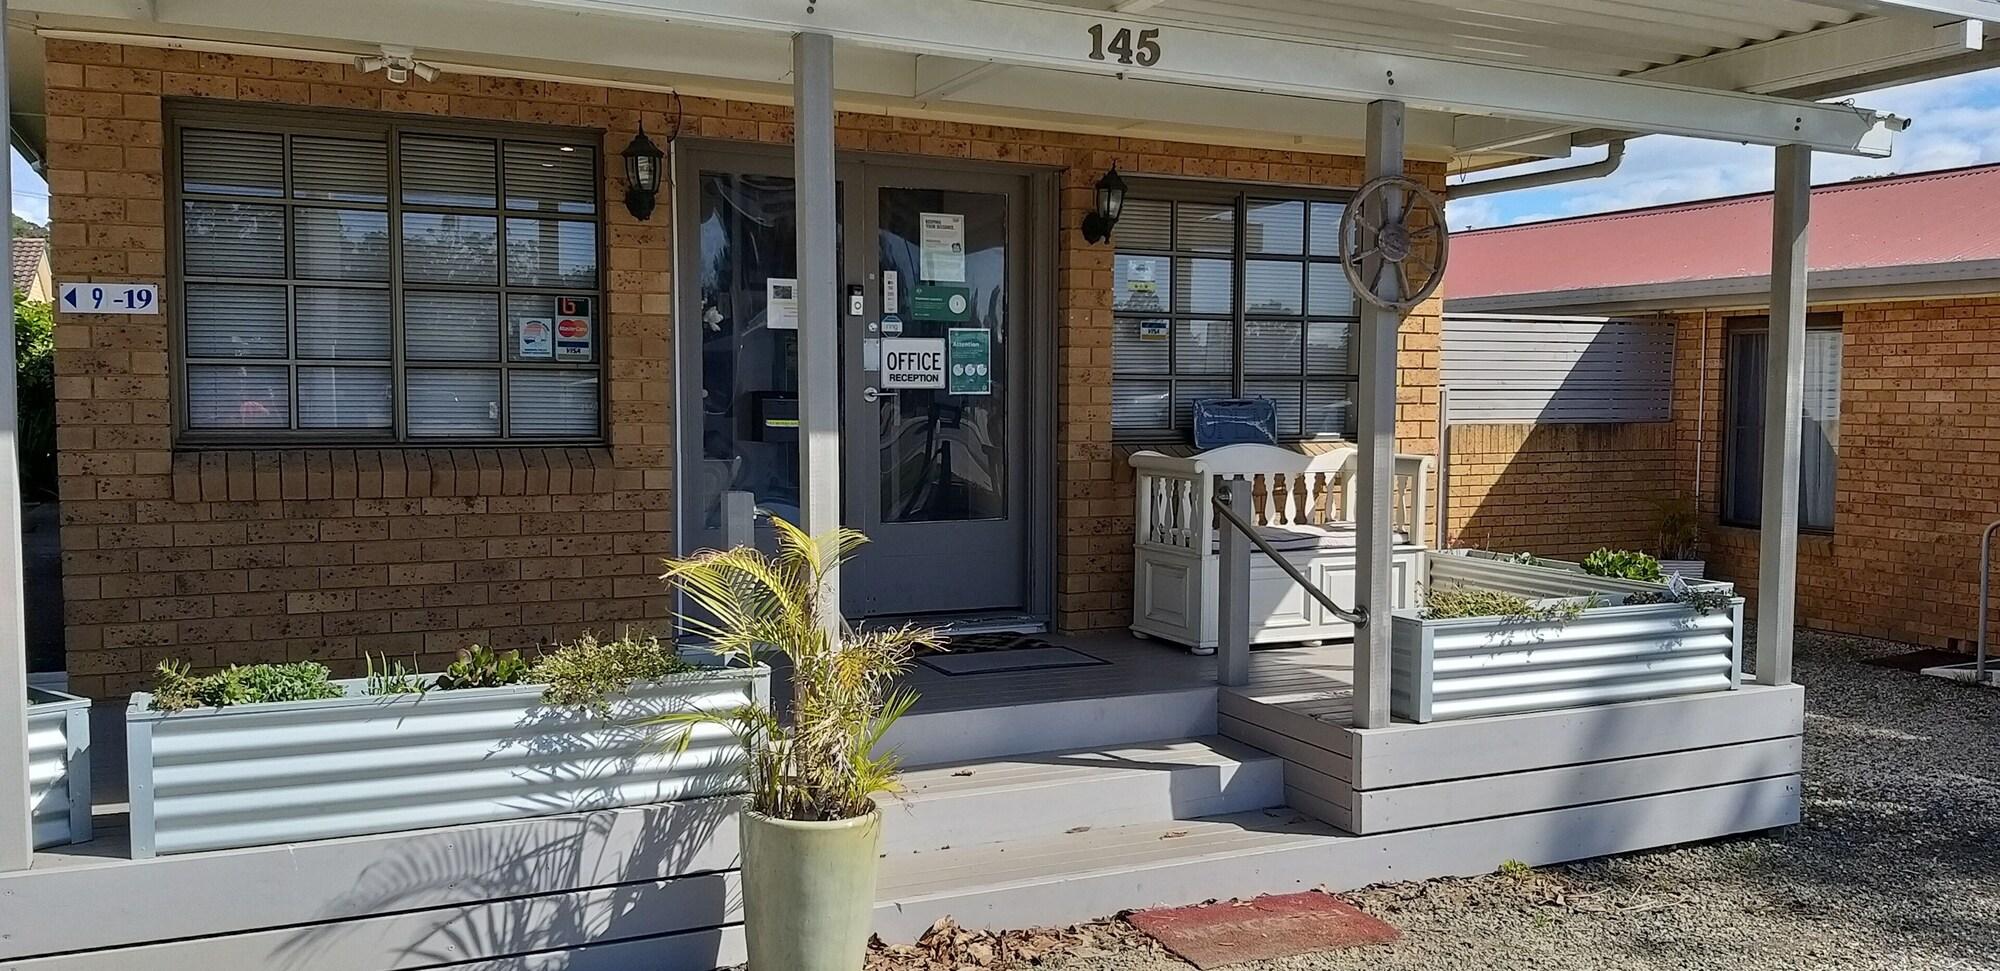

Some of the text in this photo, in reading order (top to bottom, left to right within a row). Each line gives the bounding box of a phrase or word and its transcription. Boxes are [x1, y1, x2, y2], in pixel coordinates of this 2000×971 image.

[1087, 23, 1161, 67] 145
[92, 287, 103, 309] 9
[887, 351, 942, 371] OFFICE
[889, 373, 939, 383] RECEPTION
